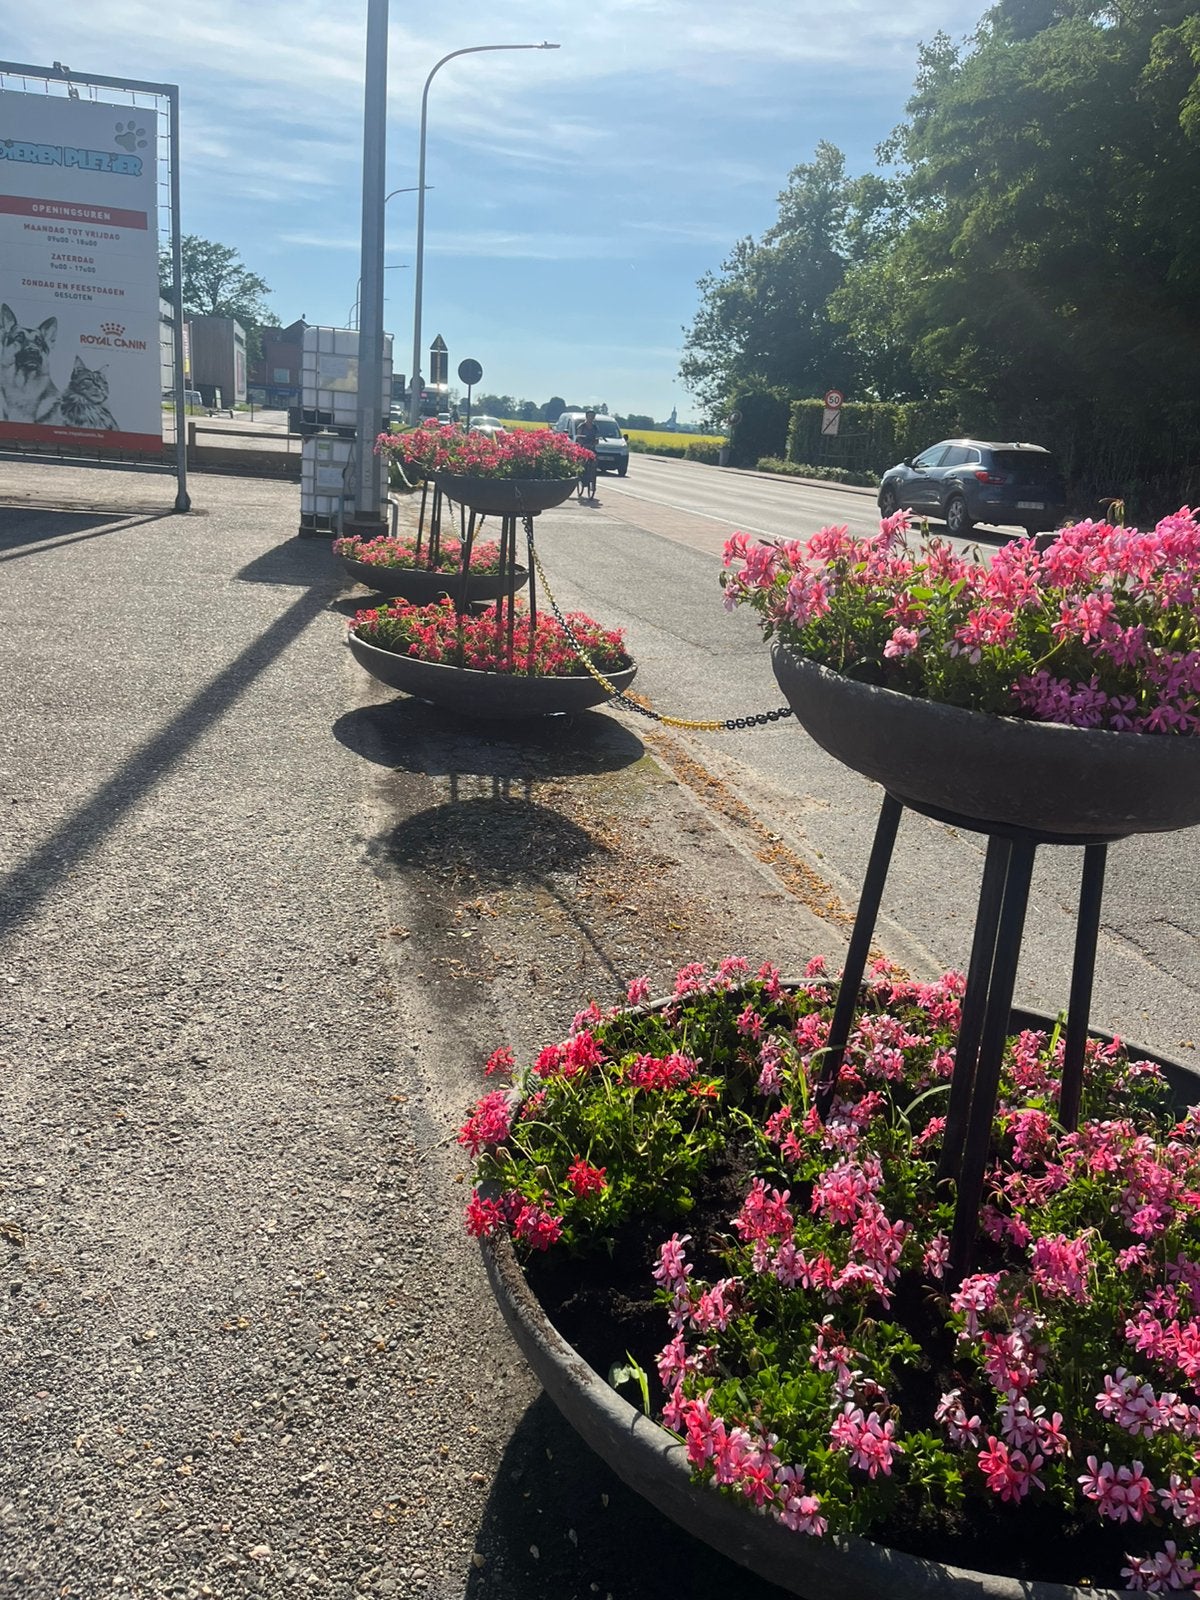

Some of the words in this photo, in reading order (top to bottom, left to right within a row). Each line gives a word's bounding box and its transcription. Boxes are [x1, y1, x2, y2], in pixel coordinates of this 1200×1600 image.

[32, 204, 111, 220] OPENINGSUREN
[23, 223, 65, 234] MAANDAG
[67, 228, 82, 236] TOT
[85, 230, 121, 241] VRIJDAG
[51, 253, 95, 263] ZATERDAG
[21, 278, 55, 289] ZONDAG
[71, 284, 125, 296] FEESTDAGEN
[54, 291, 93, 301] GESLOTEN
[80, 334, 112, 346] ROYAL
[114, 338, 147, 350] CANIN
[829, 395, 840, 404] 50
